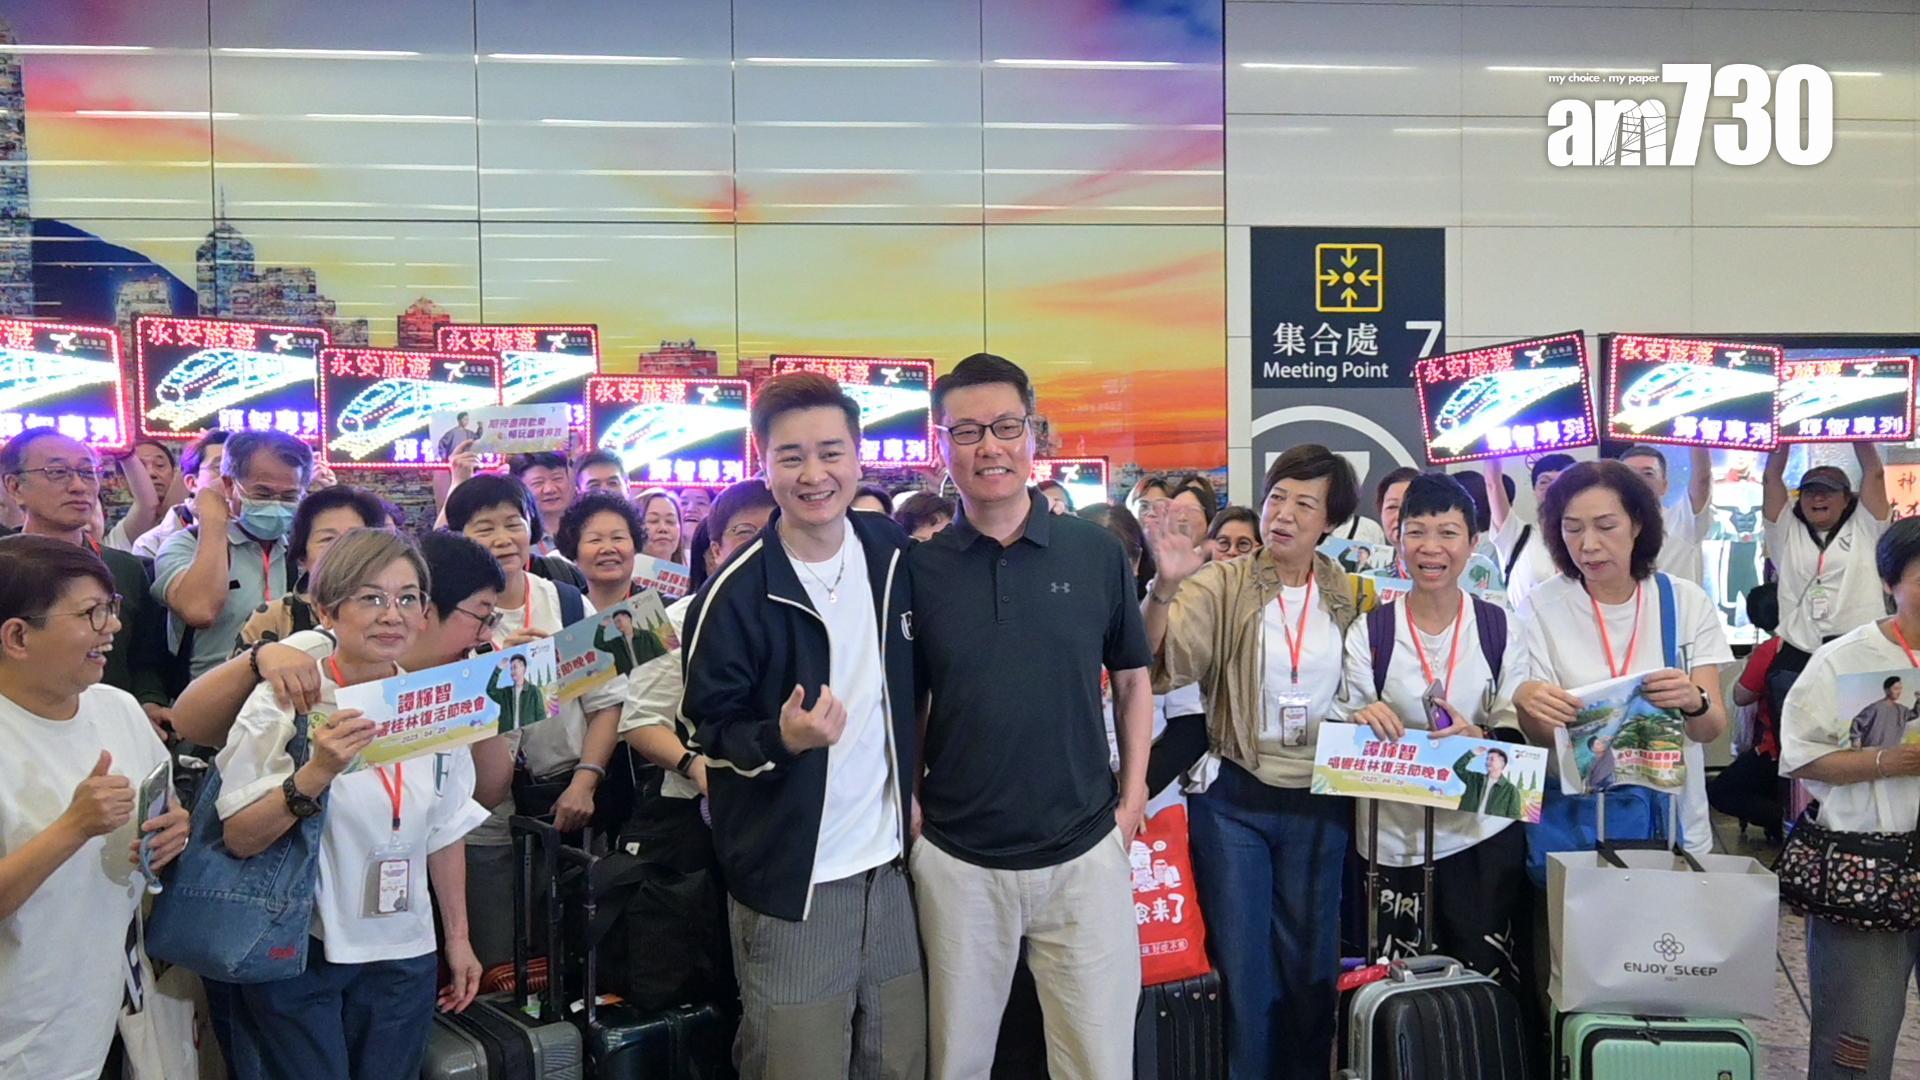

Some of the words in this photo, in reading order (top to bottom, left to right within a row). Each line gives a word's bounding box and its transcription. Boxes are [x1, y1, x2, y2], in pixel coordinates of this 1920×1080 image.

[445, 329, 538, 352] 永安旅遊
[1272, 322, 1379, 356] 集合處
[330, 353, 432, 379] 永安旅遊
[1263, 362, 1338, 382] Meeting
[1342, 362, 1389, 380] Point
[594, 380, 687, 404] 永安旅遊
[397, 682, 452, 714] 譚輝智
[1362, 740, 1417, 761] 譚輝智
[1327, 756, 1451, 782] 唱響桂林復活節晚會
[1623, 961, 1668, 975] ENJOY
[1674, 965, 1718, 977] SLEEP
